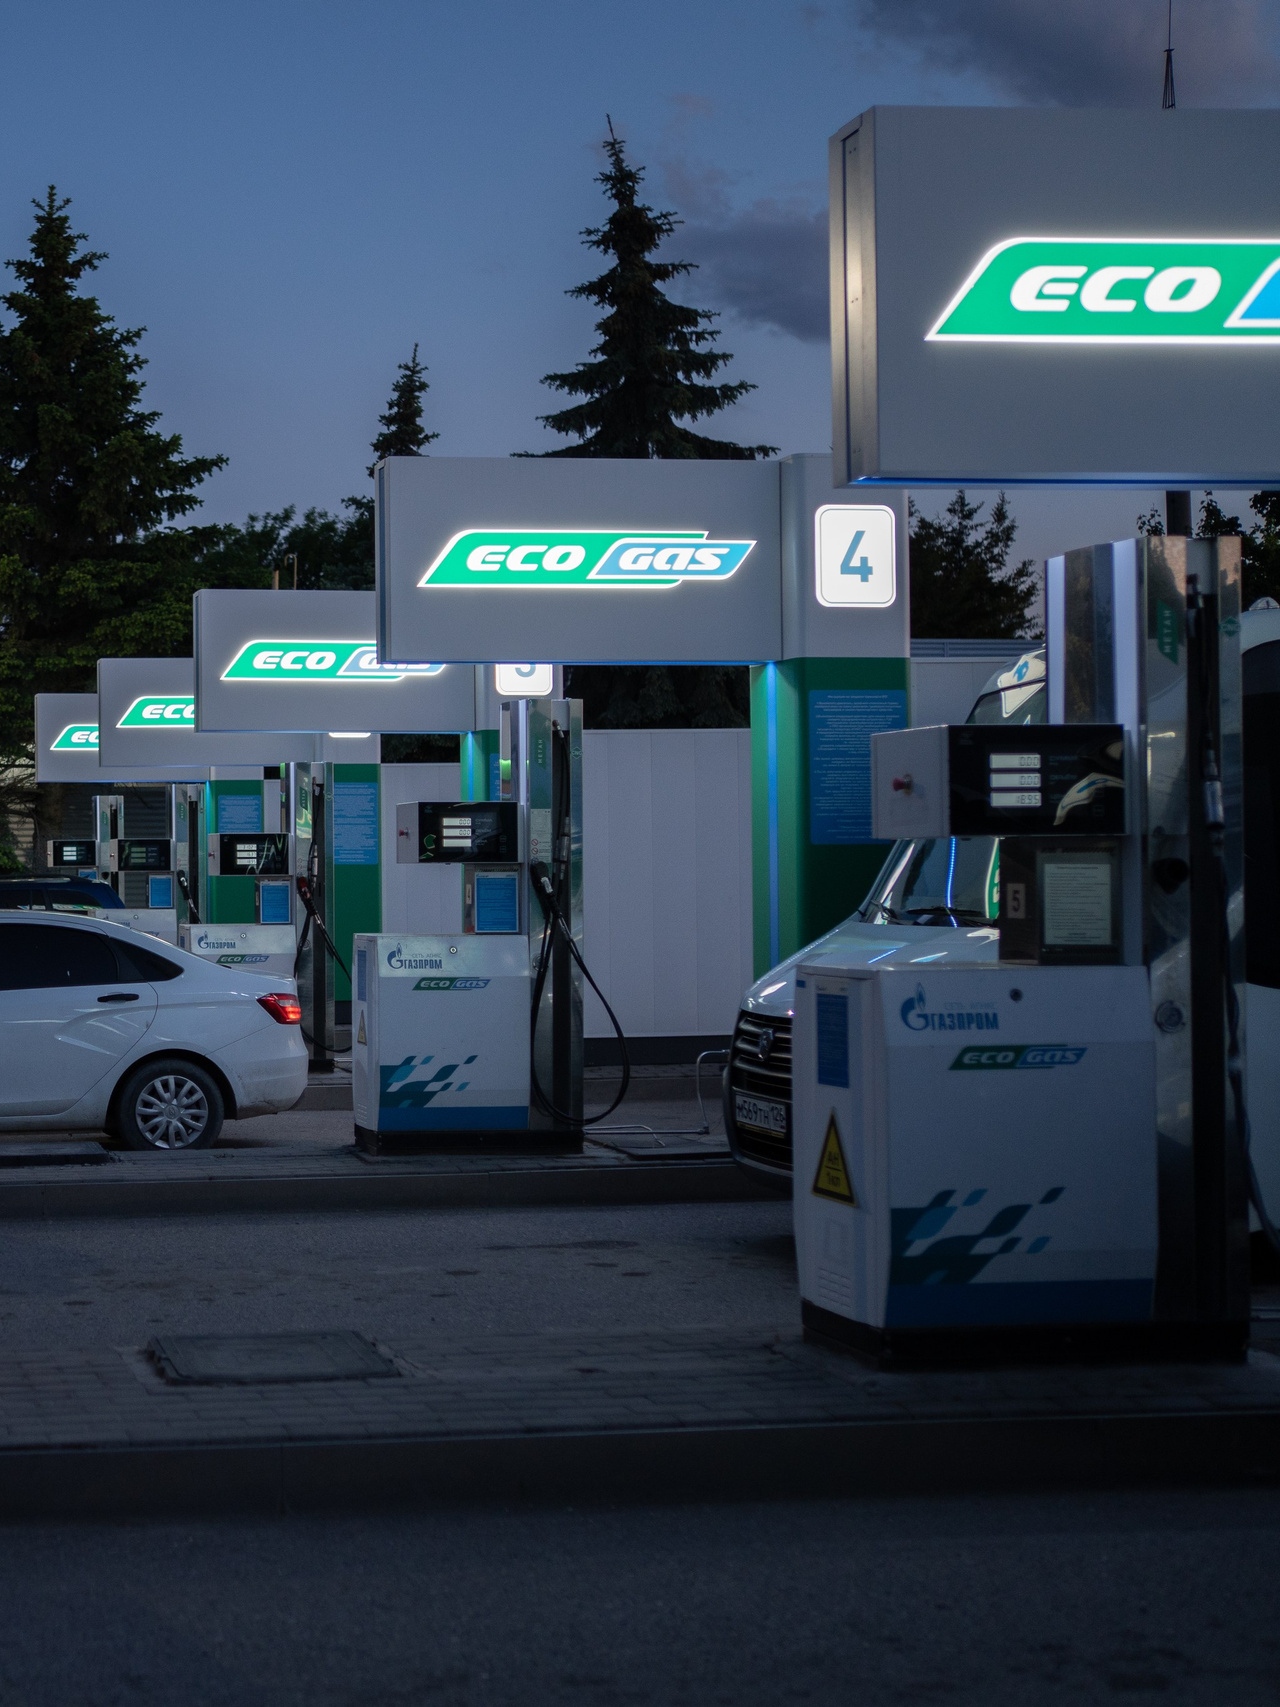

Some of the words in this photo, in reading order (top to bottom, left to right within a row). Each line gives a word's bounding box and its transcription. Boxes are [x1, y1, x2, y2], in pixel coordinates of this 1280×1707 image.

[1010, 265, 1222, 313] ECO
[466, 544, 586, 572] ECO
[840, 530, 873, 583] 4
[252, 651, 336, 670] ECO
[71, 731, 99, 743] EC
[1012, 889, 1021, 913] 5
[404, 959, 443, 970] ГАЗПРОМ
[420, 980, 450, 988] ECO
[930, 1012, 1000, 1031] ГАЗПРОМ
[962, 1051, 1016, 1065] ECO
